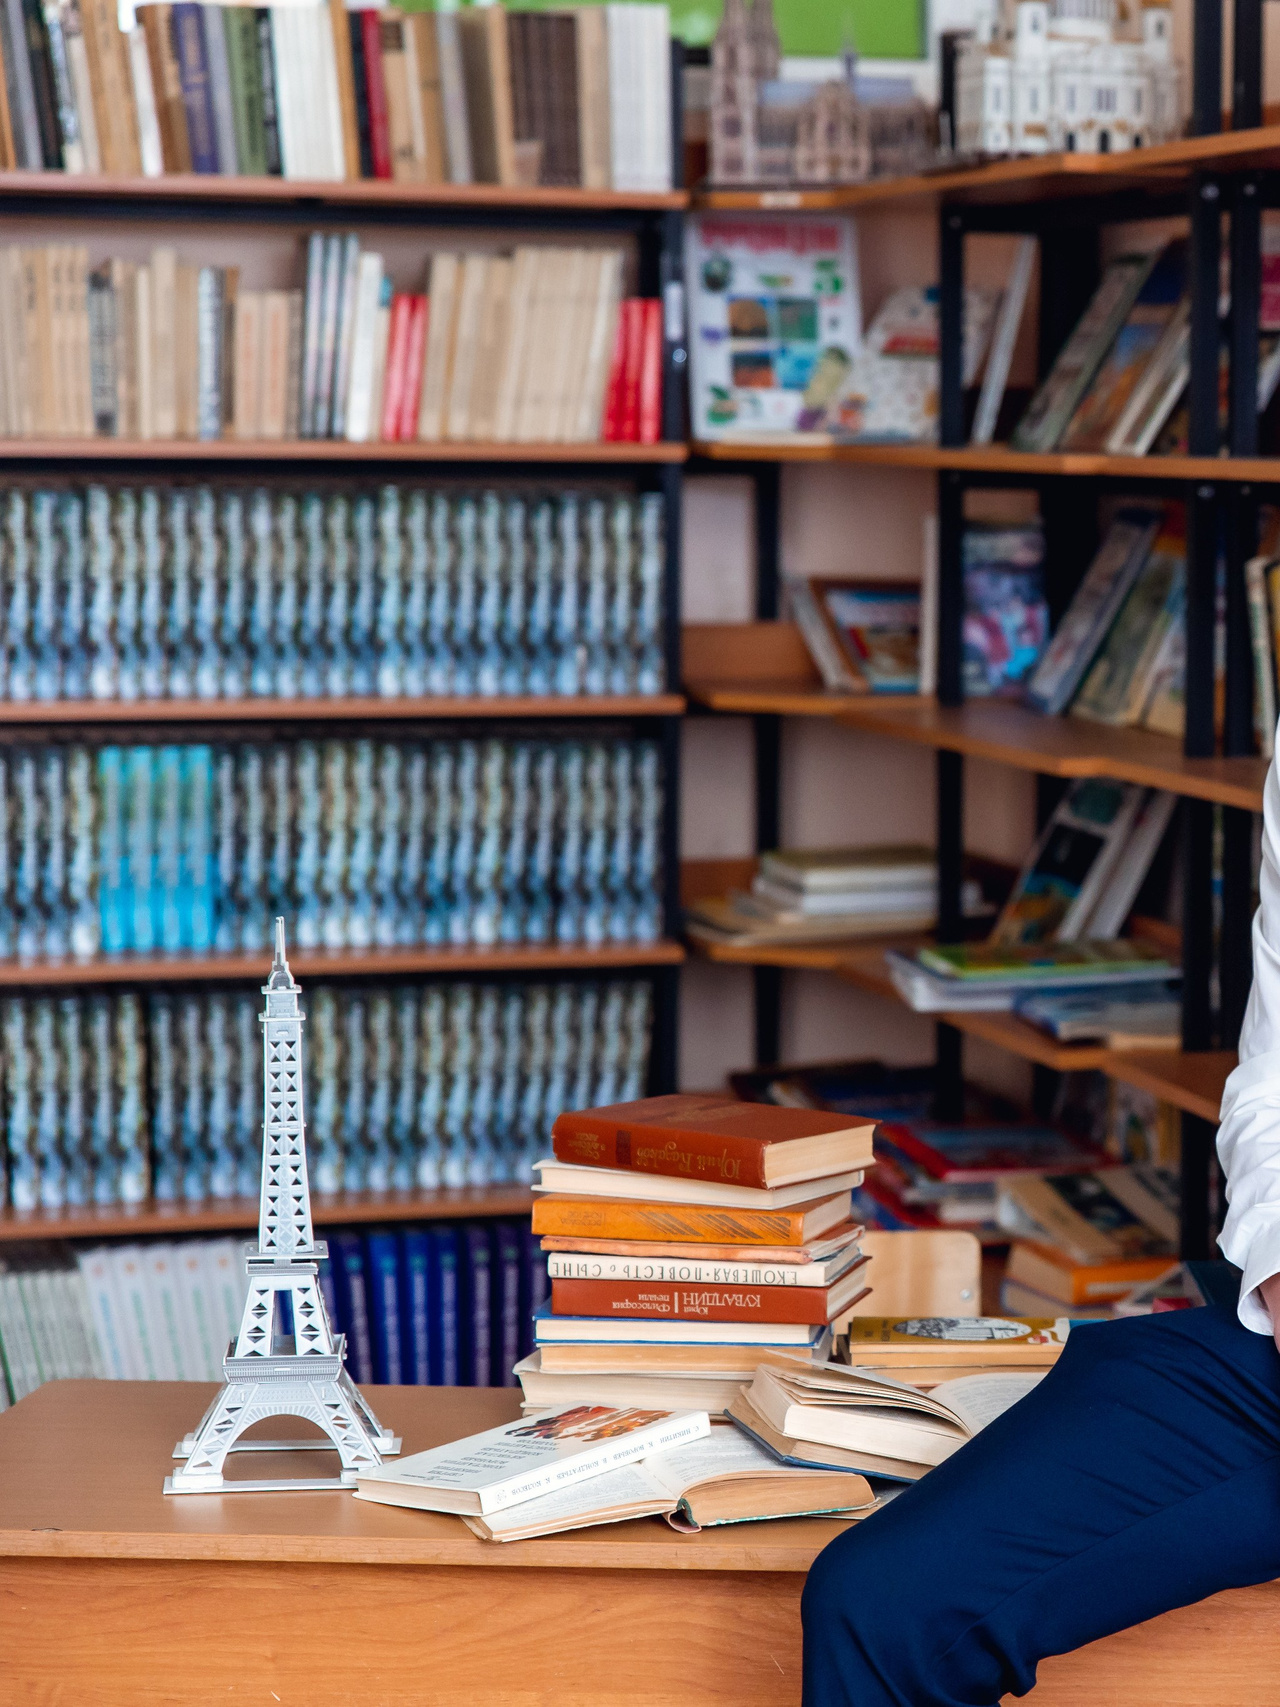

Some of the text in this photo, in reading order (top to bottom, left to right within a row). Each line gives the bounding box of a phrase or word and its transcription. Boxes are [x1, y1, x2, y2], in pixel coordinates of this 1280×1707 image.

[636, 1141, 741, 1178] Юрий Казаков
[551, 1262, 602, 1278] СЫНЕ
[622, 1264, 702, 1281] ПОВЕСТЬ
[638, 1293, 670, 1302] печали
[683, 1292, 761, 1308] КУВАЛДИН
[612, 1300, 671, 1313] Философия
[683, 1305, 709, 1315] Юрий
[511, 1427, 691, 1495] НИКИТИН ВОРОБЬЕВ КОНДРАТЬЕВ КОЛЕСОВ
